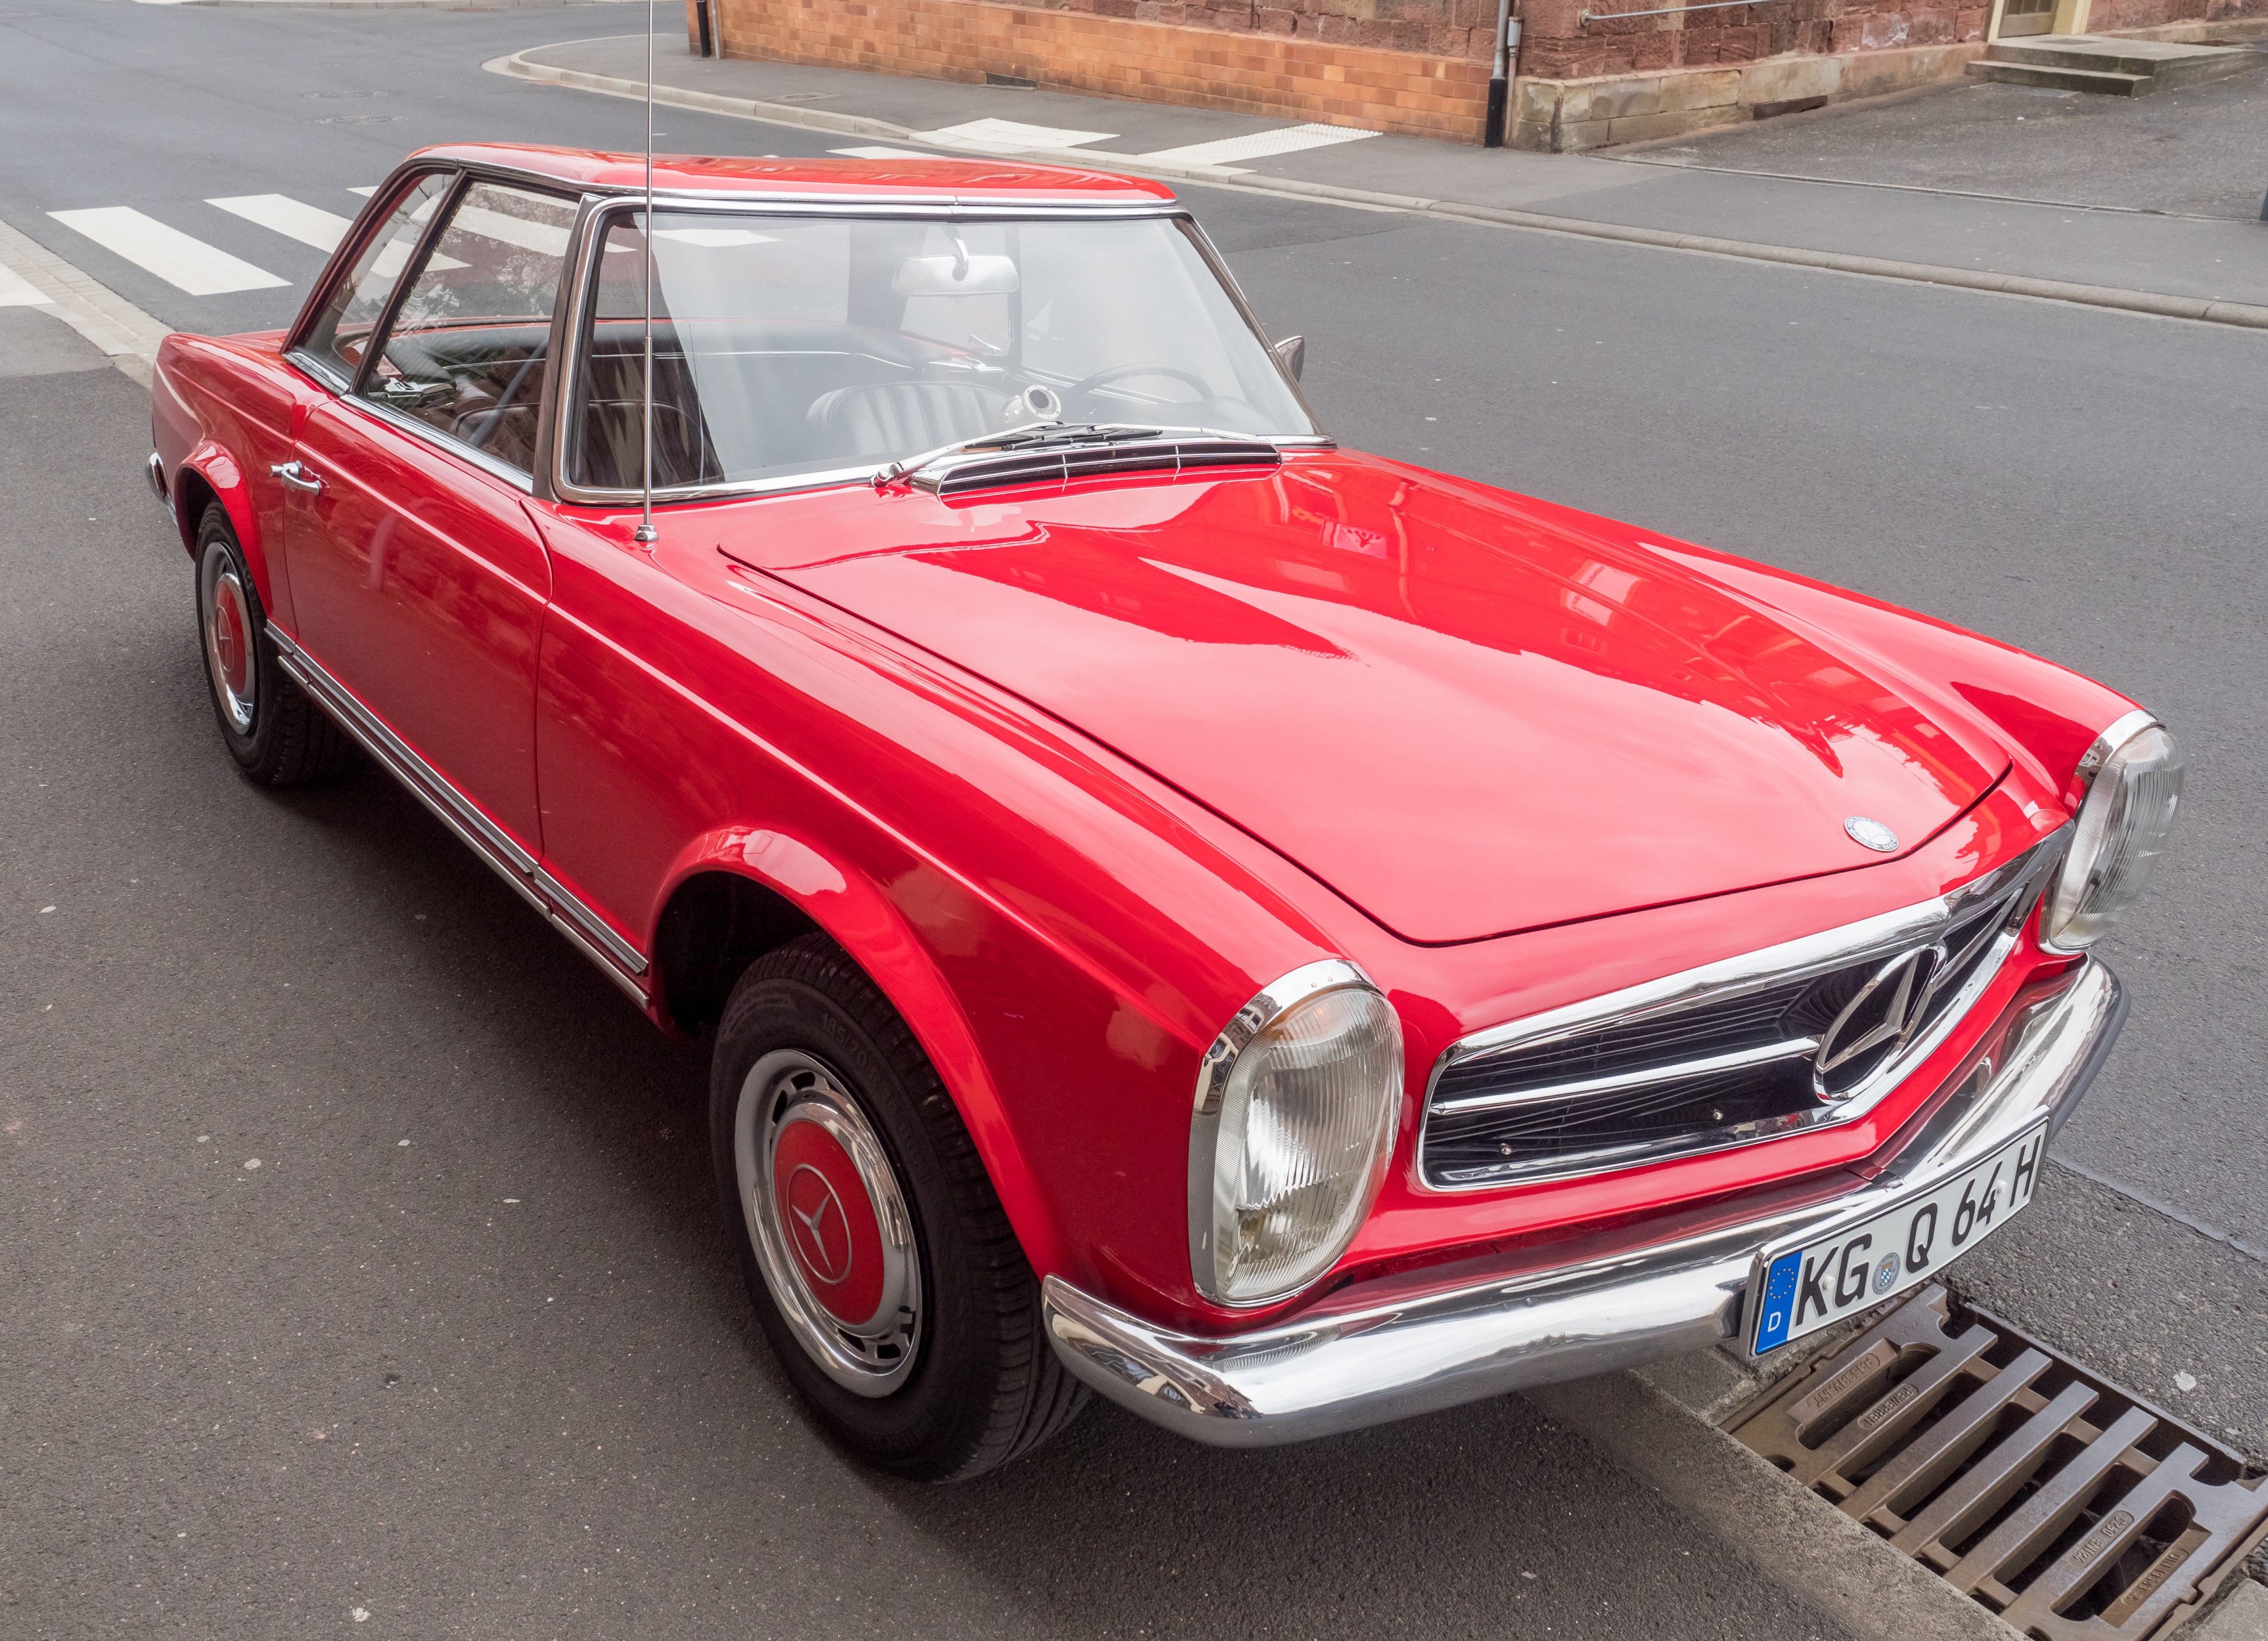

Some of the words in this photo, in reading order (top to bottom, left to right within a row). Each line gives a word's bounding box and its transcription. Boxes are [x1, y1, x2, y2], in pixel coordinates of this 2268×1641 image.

[1795, 1233, 1872, 1326] KG
[1905, 1202, 1937, 1274] Q
[1767, 1311, 1782, 1333] D
[2101, 1515, 2126, 1538] C250
